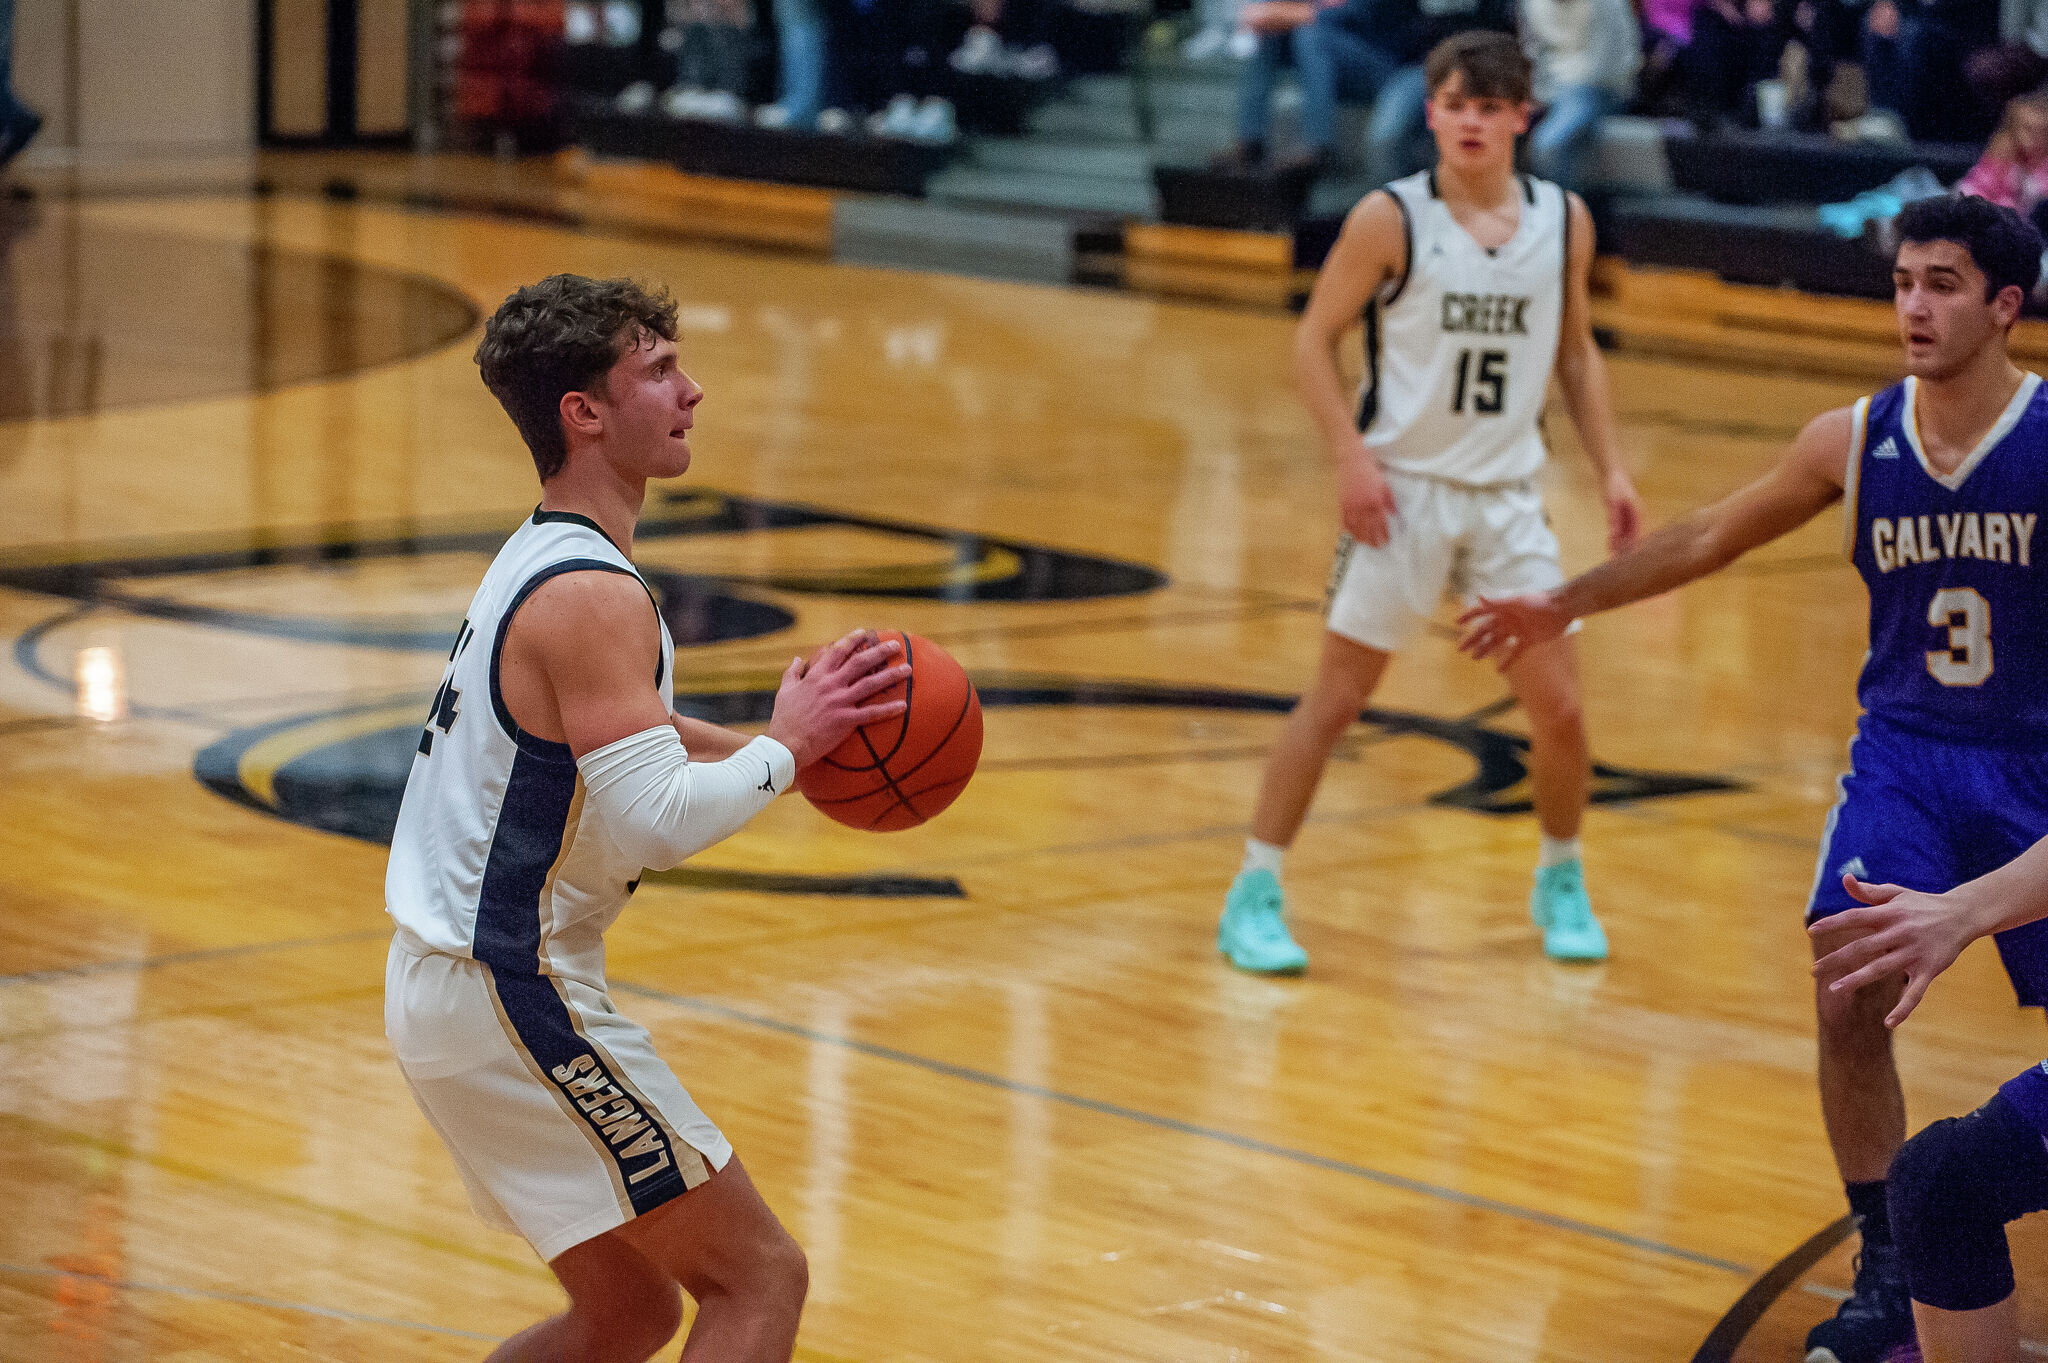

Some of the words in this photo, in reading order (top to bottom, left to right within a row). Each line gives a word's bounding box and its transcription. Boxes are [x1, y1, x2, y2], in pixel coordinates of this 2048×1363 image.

[1441, 291, 1532, 336] CREEK
[1451, 348, 1507, 415] 15
[1872, 512, 2036, 573] CALVARY
[1925, 586, 1994, 687] 3
[551, 1053, 671, 1185] LANCERS
